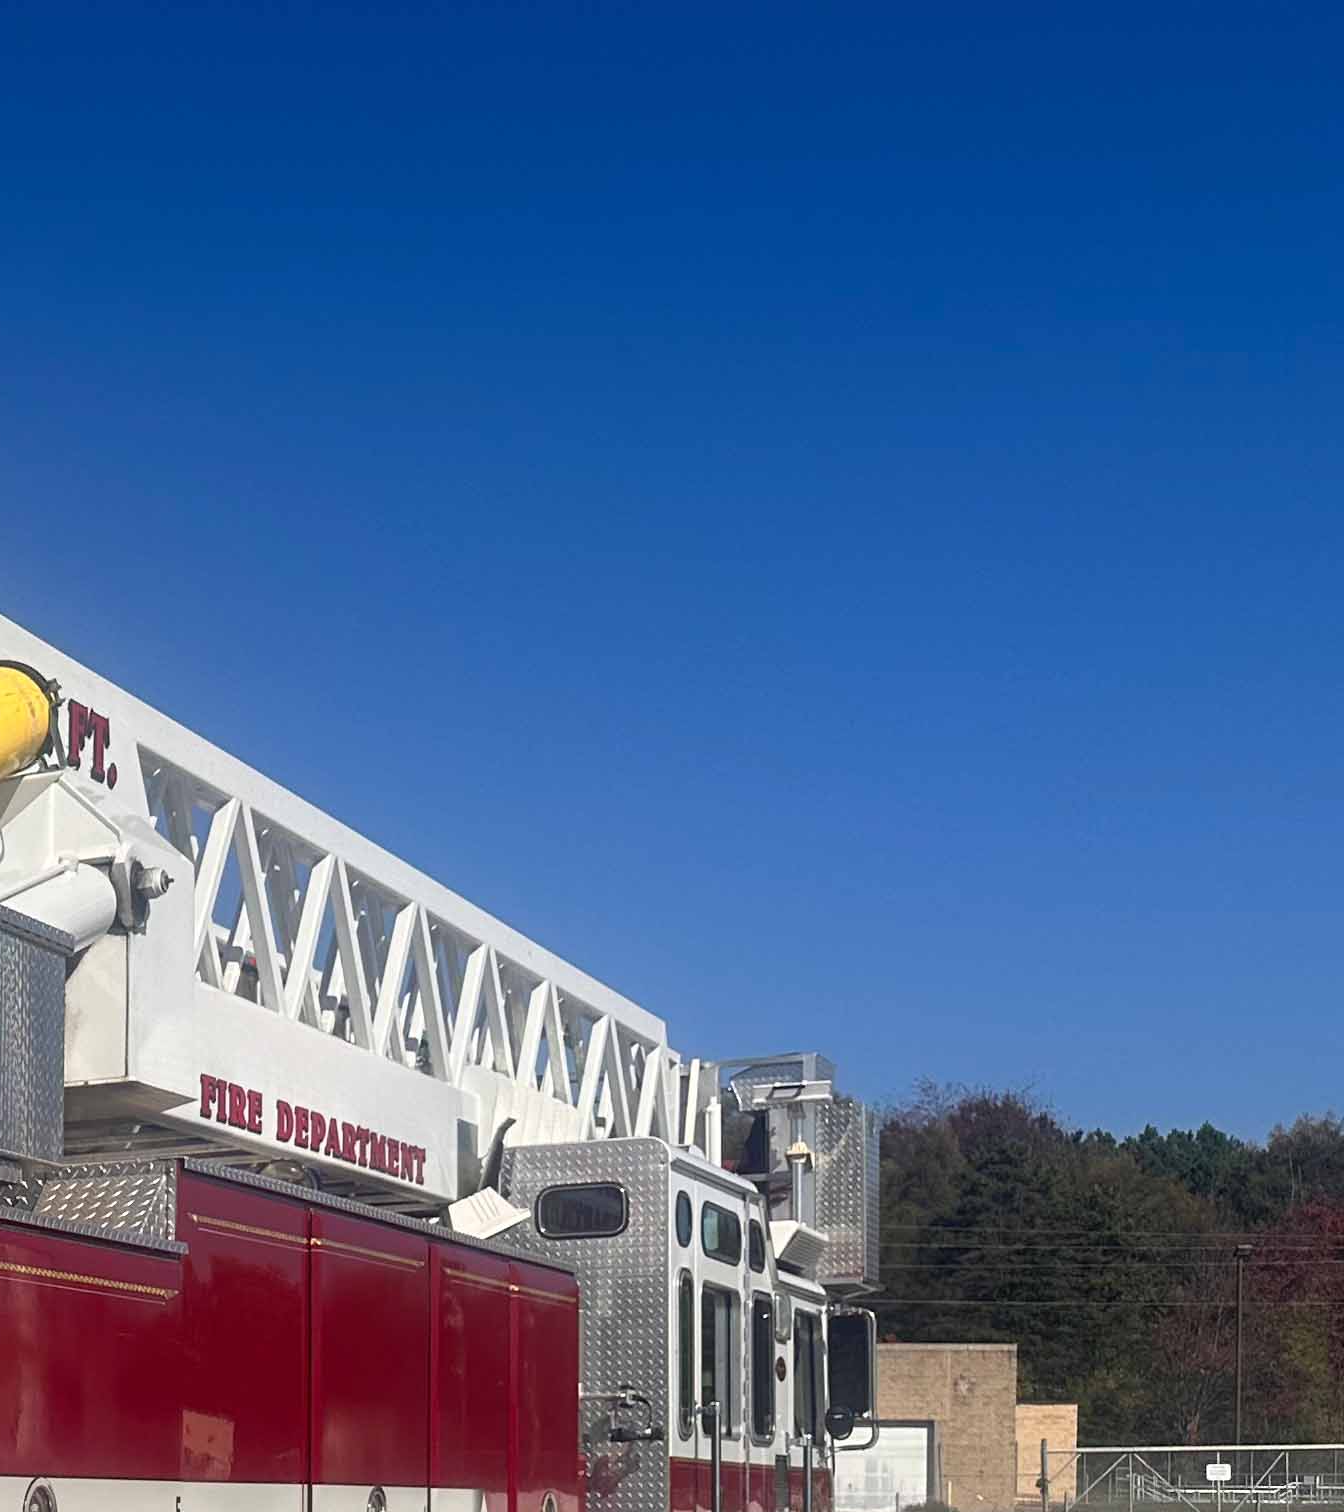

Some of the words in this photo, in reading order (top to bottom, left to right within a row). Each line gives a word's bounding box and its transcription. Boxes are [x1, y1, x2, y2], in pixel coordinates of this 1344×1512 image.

[67, 698, 118, 791] FT.
[200, 1073, 263, 1135] FIRE
[276, 1099, 426, 1185] DEPARTMENT
